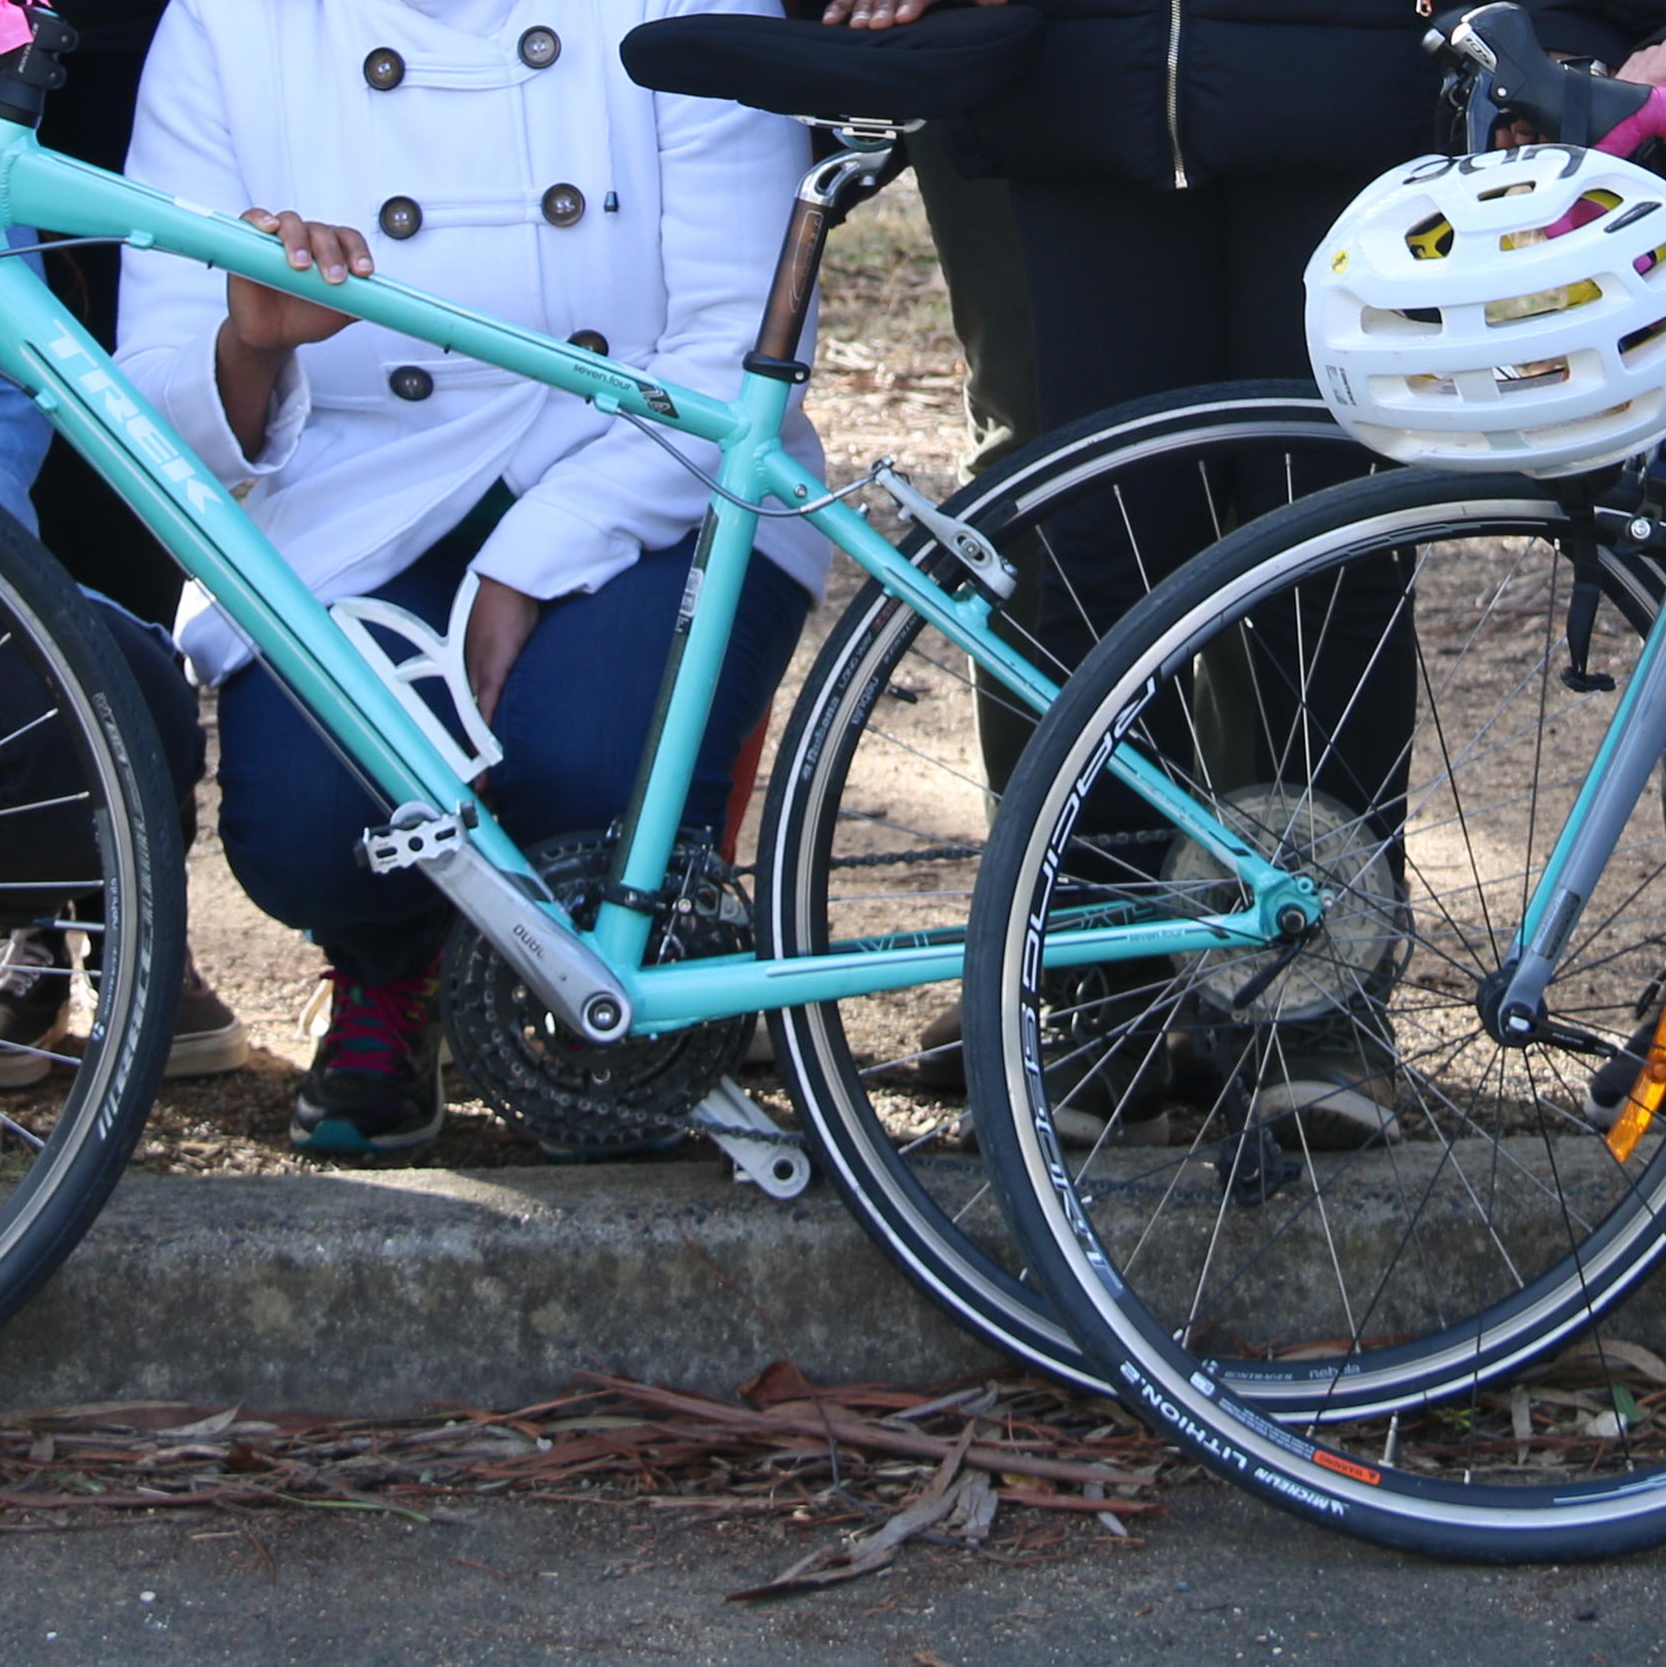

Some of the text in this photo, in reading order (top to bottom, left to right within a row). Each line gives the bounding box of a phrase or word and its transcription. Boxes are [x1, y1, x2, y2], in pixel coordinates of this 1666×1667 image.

[45, 319, 225, 514] TREK
[1119, 1360, 1249, 1470] LITHION.2
[1254, 1466, 1329, 1512] MICHELIN
